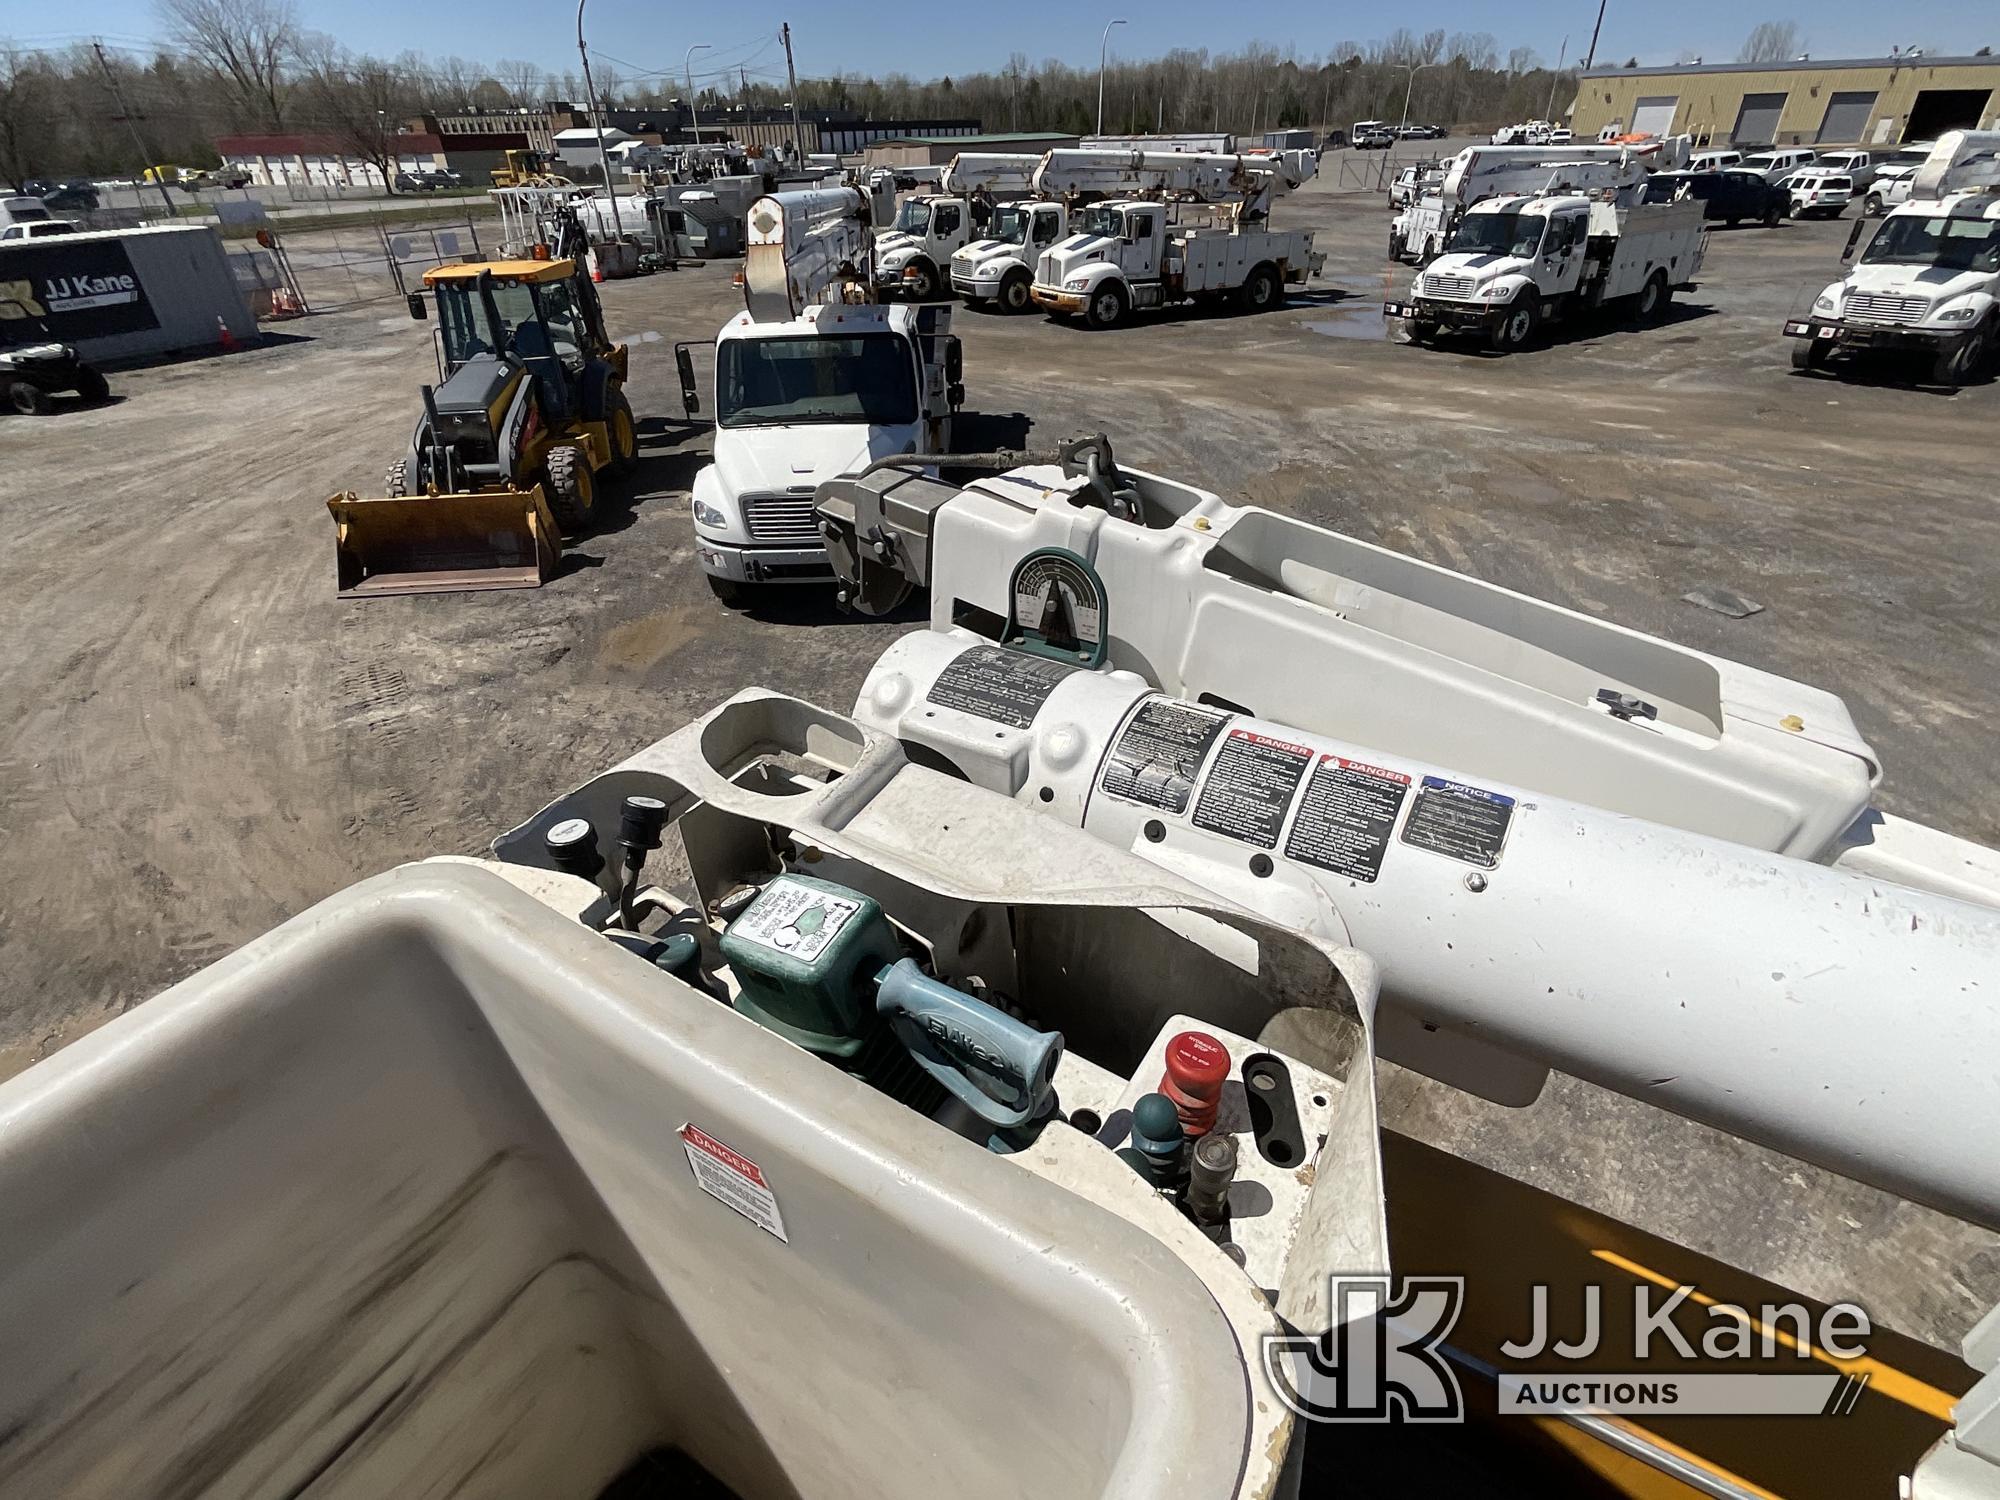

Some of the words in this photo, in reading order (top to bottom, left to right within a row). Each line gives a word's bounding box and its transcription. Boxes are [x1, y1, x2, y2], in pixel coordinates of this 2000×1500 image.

[46, 278, 71, 299] JJ
[72, 274, 136, 296] Kane
[1256, 736, 1308, 756] DANGER
[1348, 762, 1404, 783] DANGER
[1445, 782, 1492, 799] NOTICE
[693, 1133, 752, 1176] DANGER
